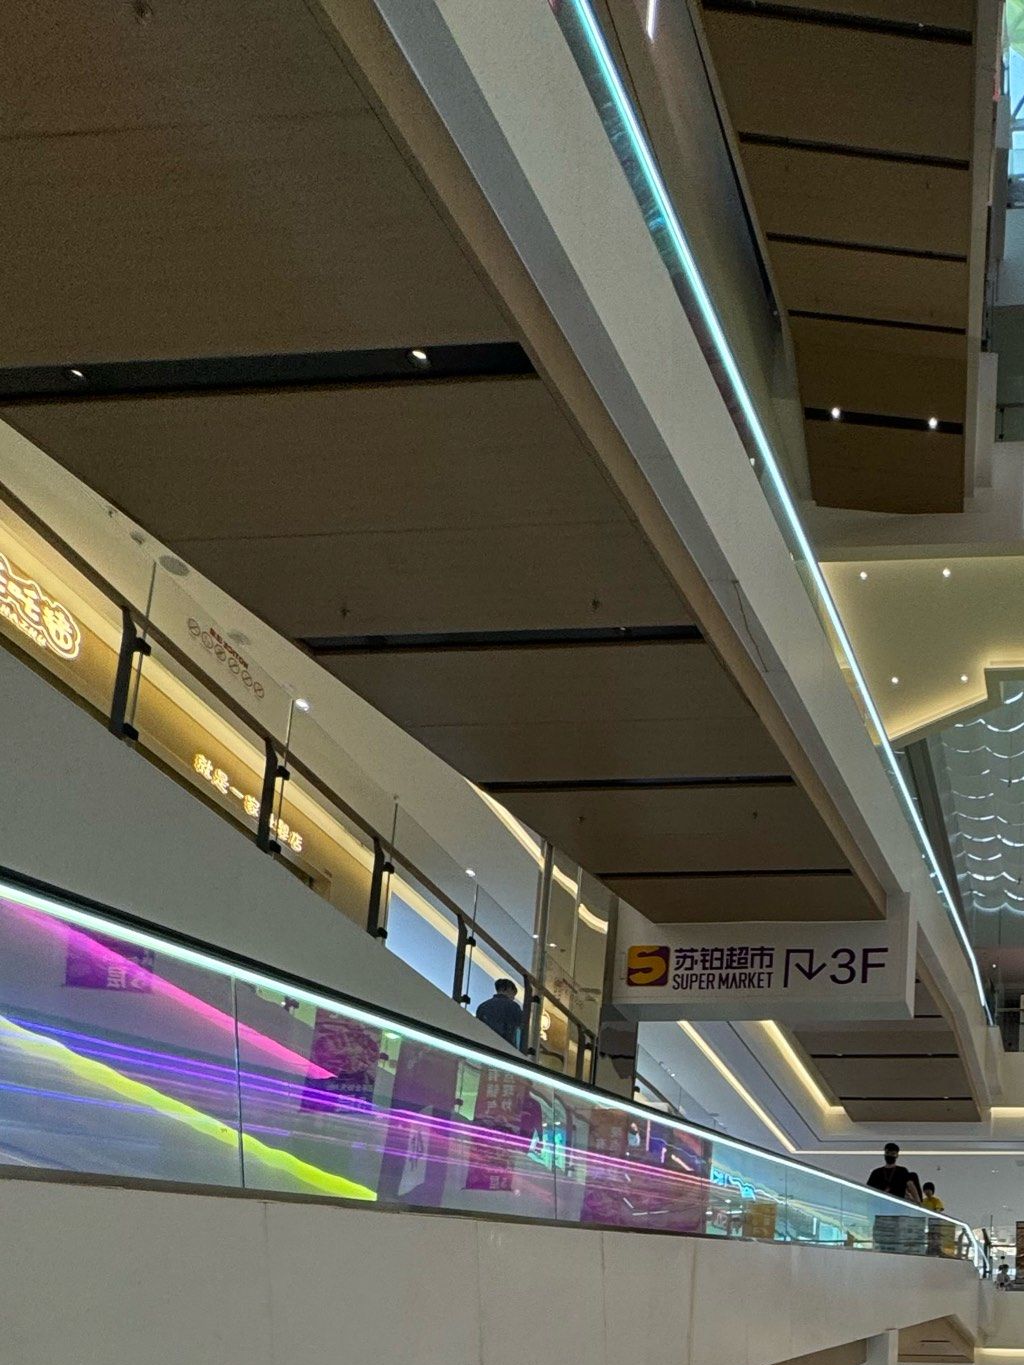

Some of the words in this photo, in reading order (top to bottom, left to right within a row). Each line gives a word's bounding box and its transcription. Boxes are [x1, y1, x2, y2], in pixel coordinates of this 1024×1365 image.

[674, 946, 775, 971] 苏铂超市
[830, 947, 889, 985] 3F
[672, 972, 715, 990] SUPER
[720, 971, 773, 989] MARKET
